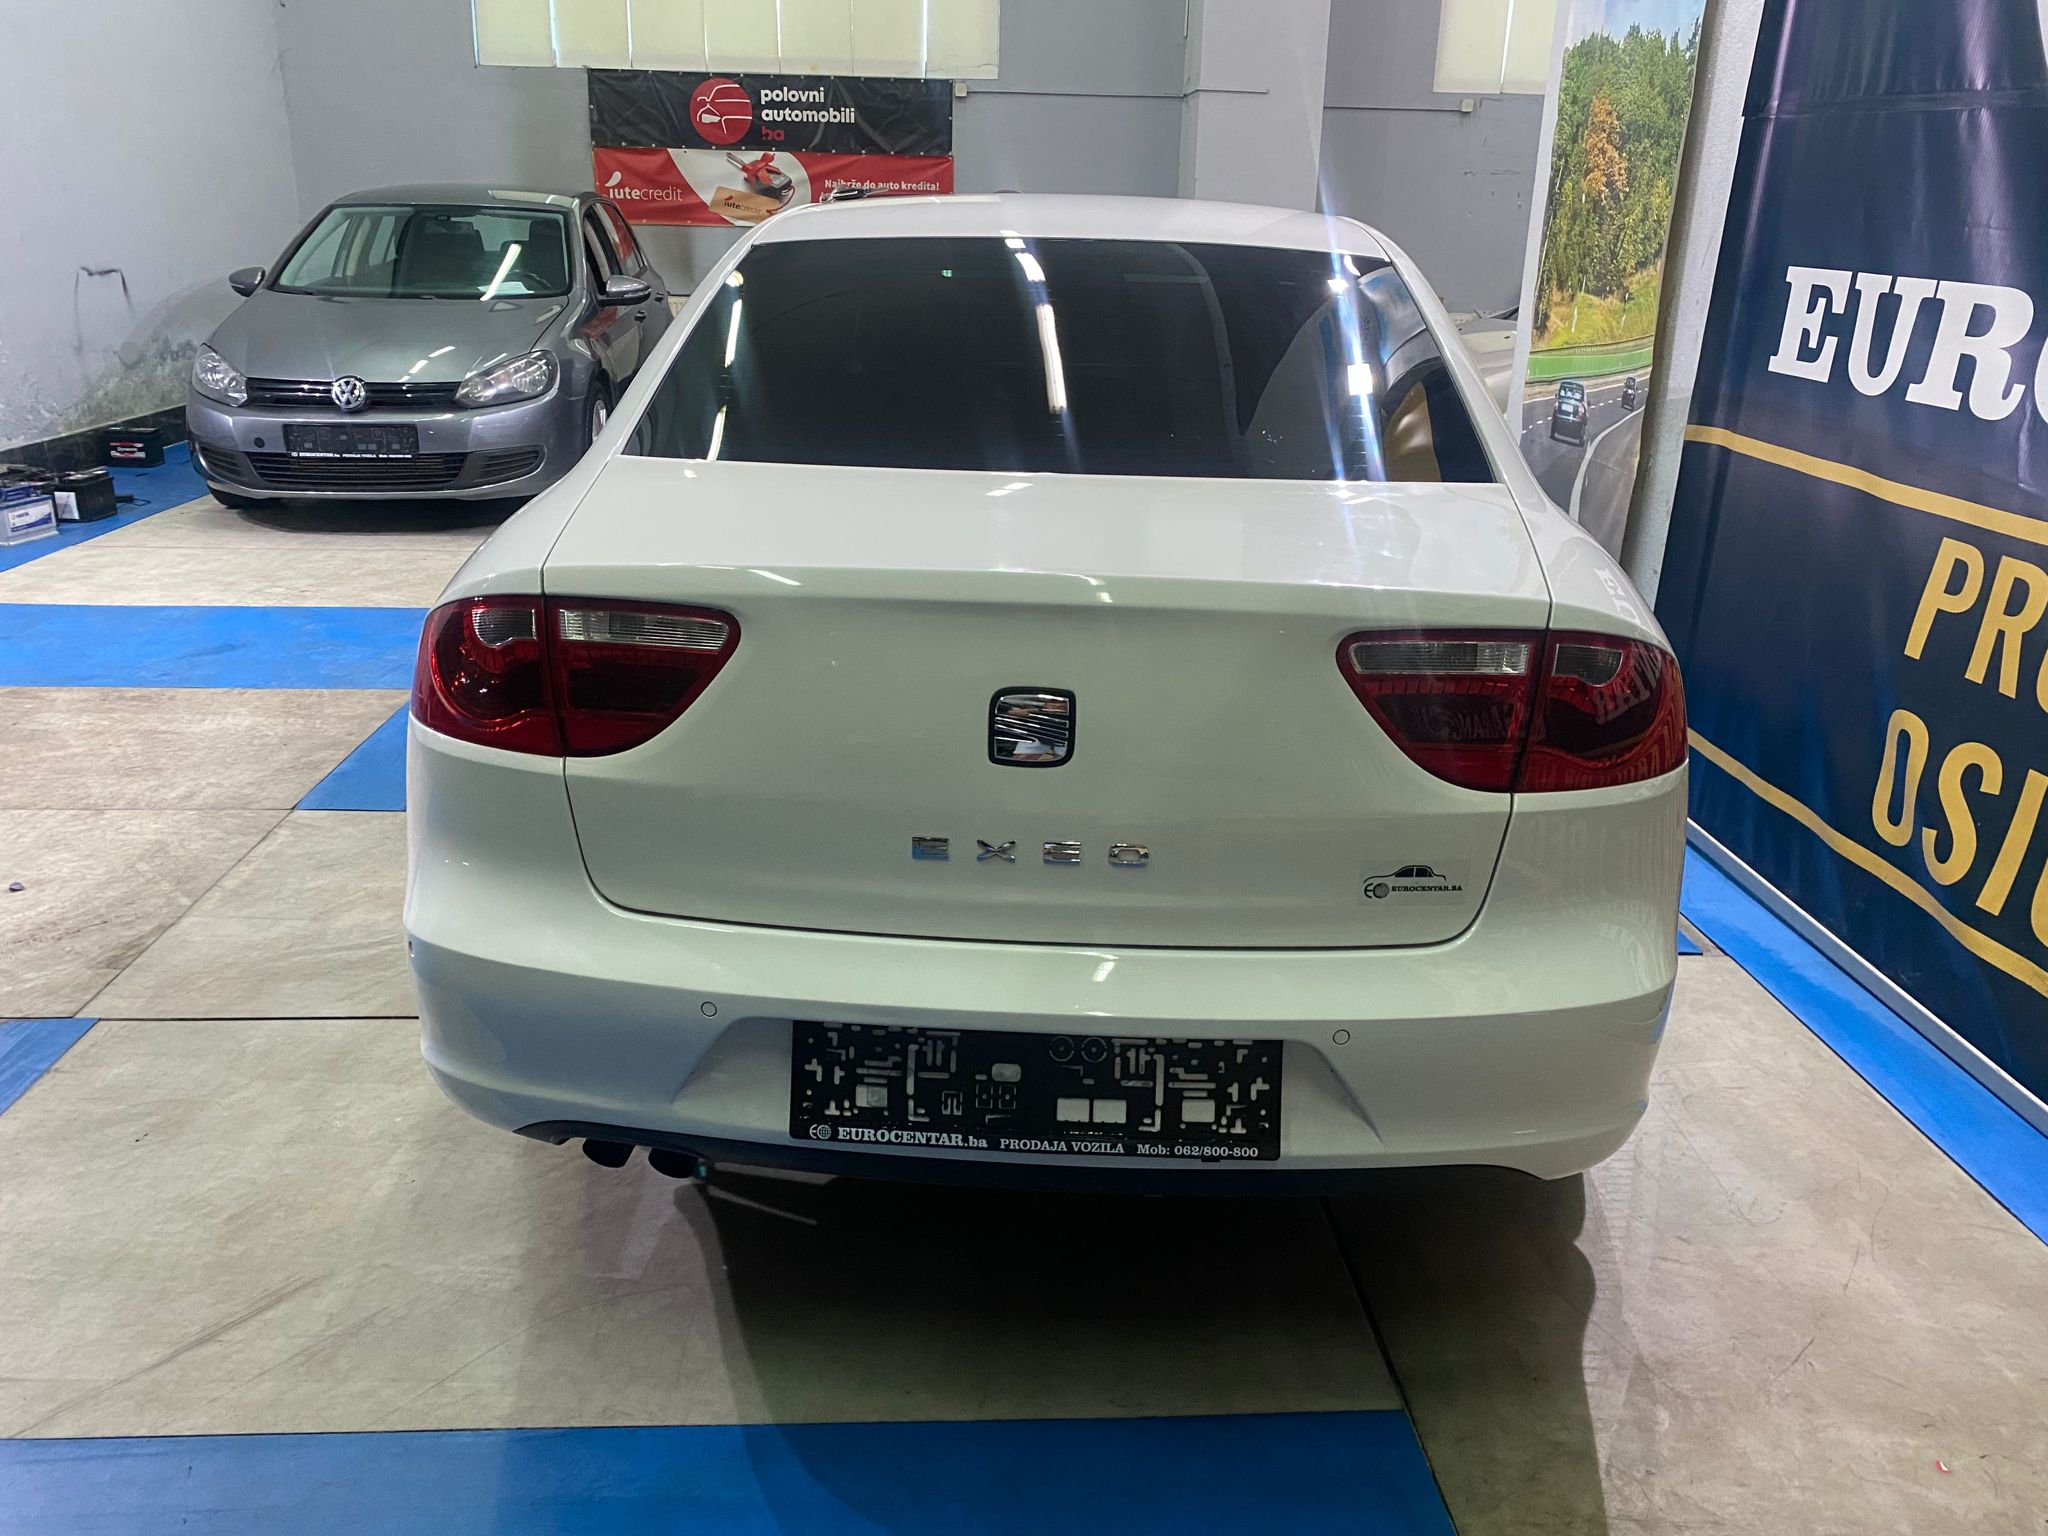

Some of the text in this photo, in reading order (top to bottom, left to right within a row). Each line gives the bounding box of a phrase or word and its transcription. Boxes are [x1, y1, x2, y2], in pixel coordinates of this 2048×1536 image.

[760, 86, 825, 104] polovni
[761, 107, 855, 123] automobili
[608, 184, 683, 202] iutecredit
[863, 180, 876, 189] do
[901, 181, 940, 191] kredita!
[1767, 265, 2048, 425] EUR
[1903, 536, 2048, 715] PR
[1872, 708, 2048, 949] OSI
[911, 835, 1150, 866] EXEO
[1391, 885, 1463, 893] EUROCENTAR.BA
[837, 1126, 1259, 1158] EUROCENTAR.ba PRODAJA VOZILA Mob: 062/800-800
